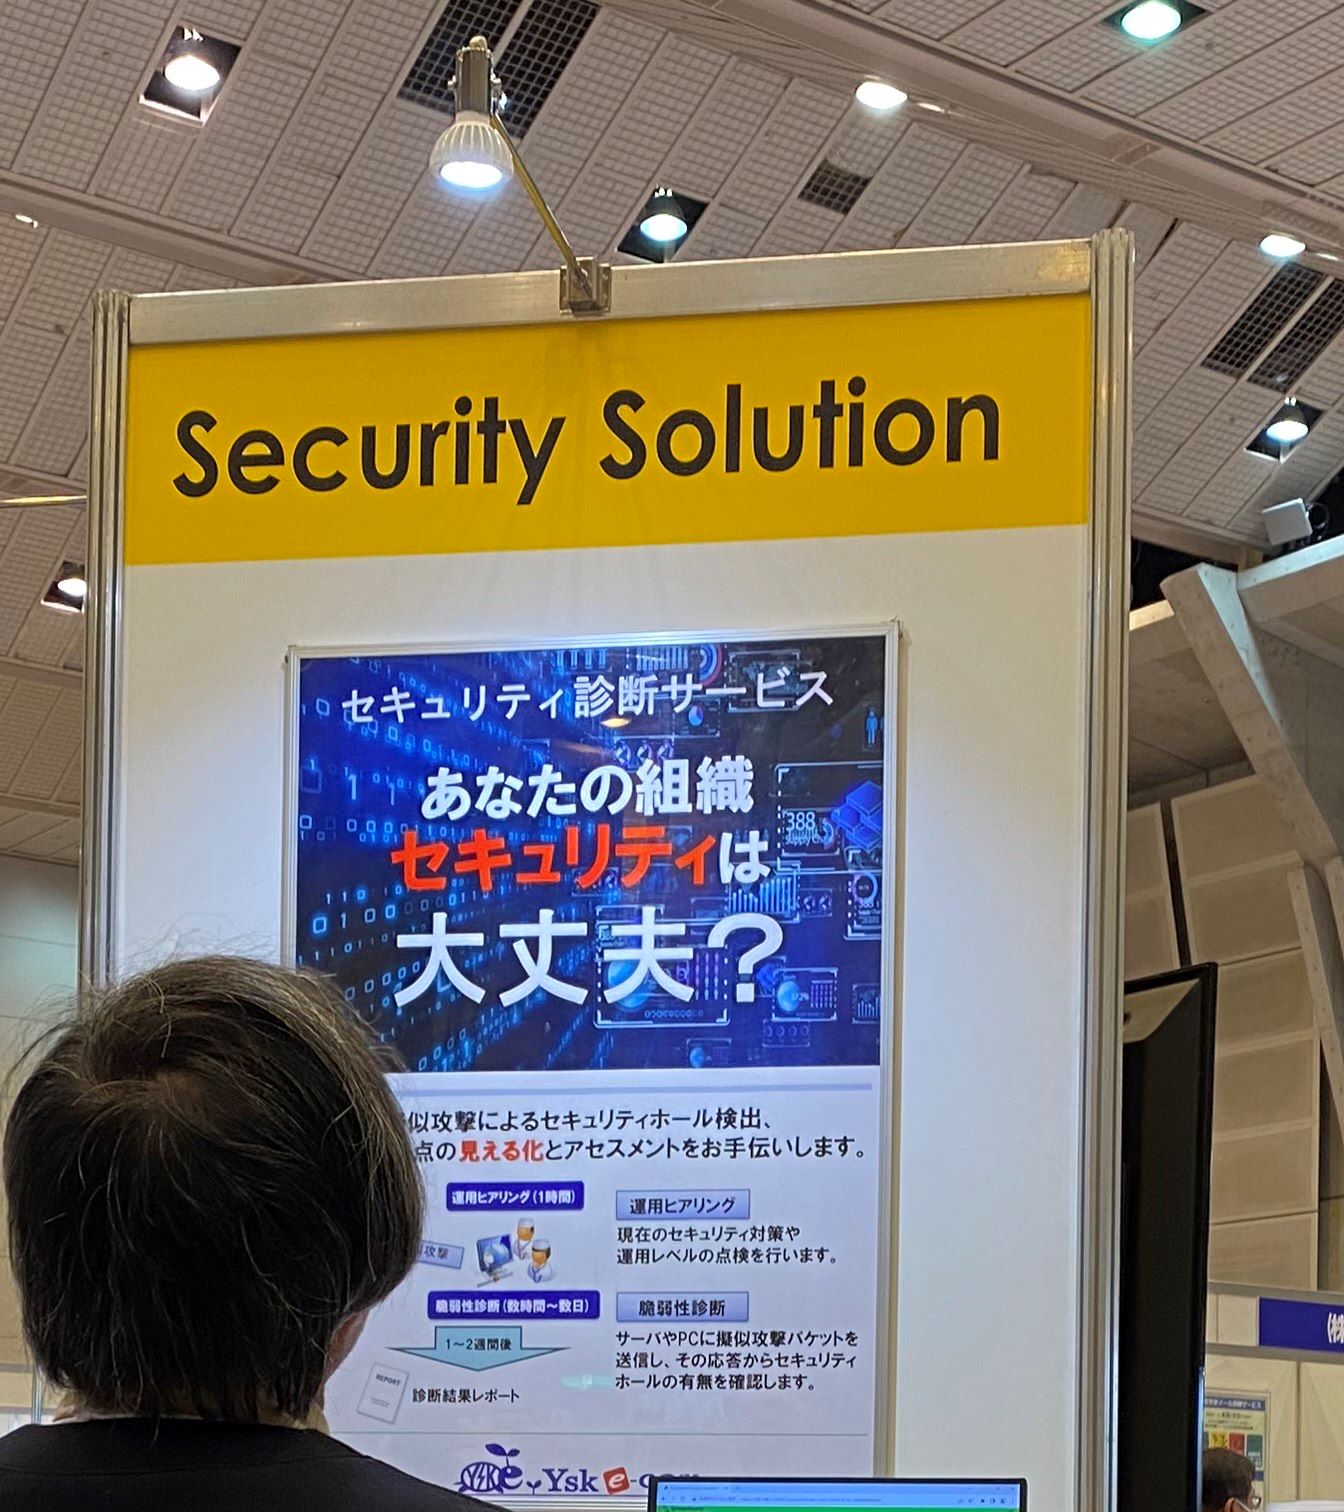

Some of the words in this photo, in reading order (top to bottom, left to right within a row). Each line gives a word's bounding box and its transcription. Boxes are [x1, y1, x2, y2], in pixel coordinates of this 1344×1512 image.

[172, 395, 565, 504] Security
[600, 375, 999, 479] Solution
[340, 670, 834, 725] セキュリティ診断サービス
[420, 756, 754, 820] あなたの組織
[391, 826, 772, 892] セキュリティは
[394, 906, 784, 1008] 大丈夫?
[630, 1197, 736, 1215] 運用ヒアリング
[420, 1243, 449, 1259] 攻撃
[617, 1225, 801, 1243] 現在のセキュリティ対策や
[638, 1299, 726, 1318] 脆弱性診断
[413, 1388, 520, 1403] 診断結果レポート
